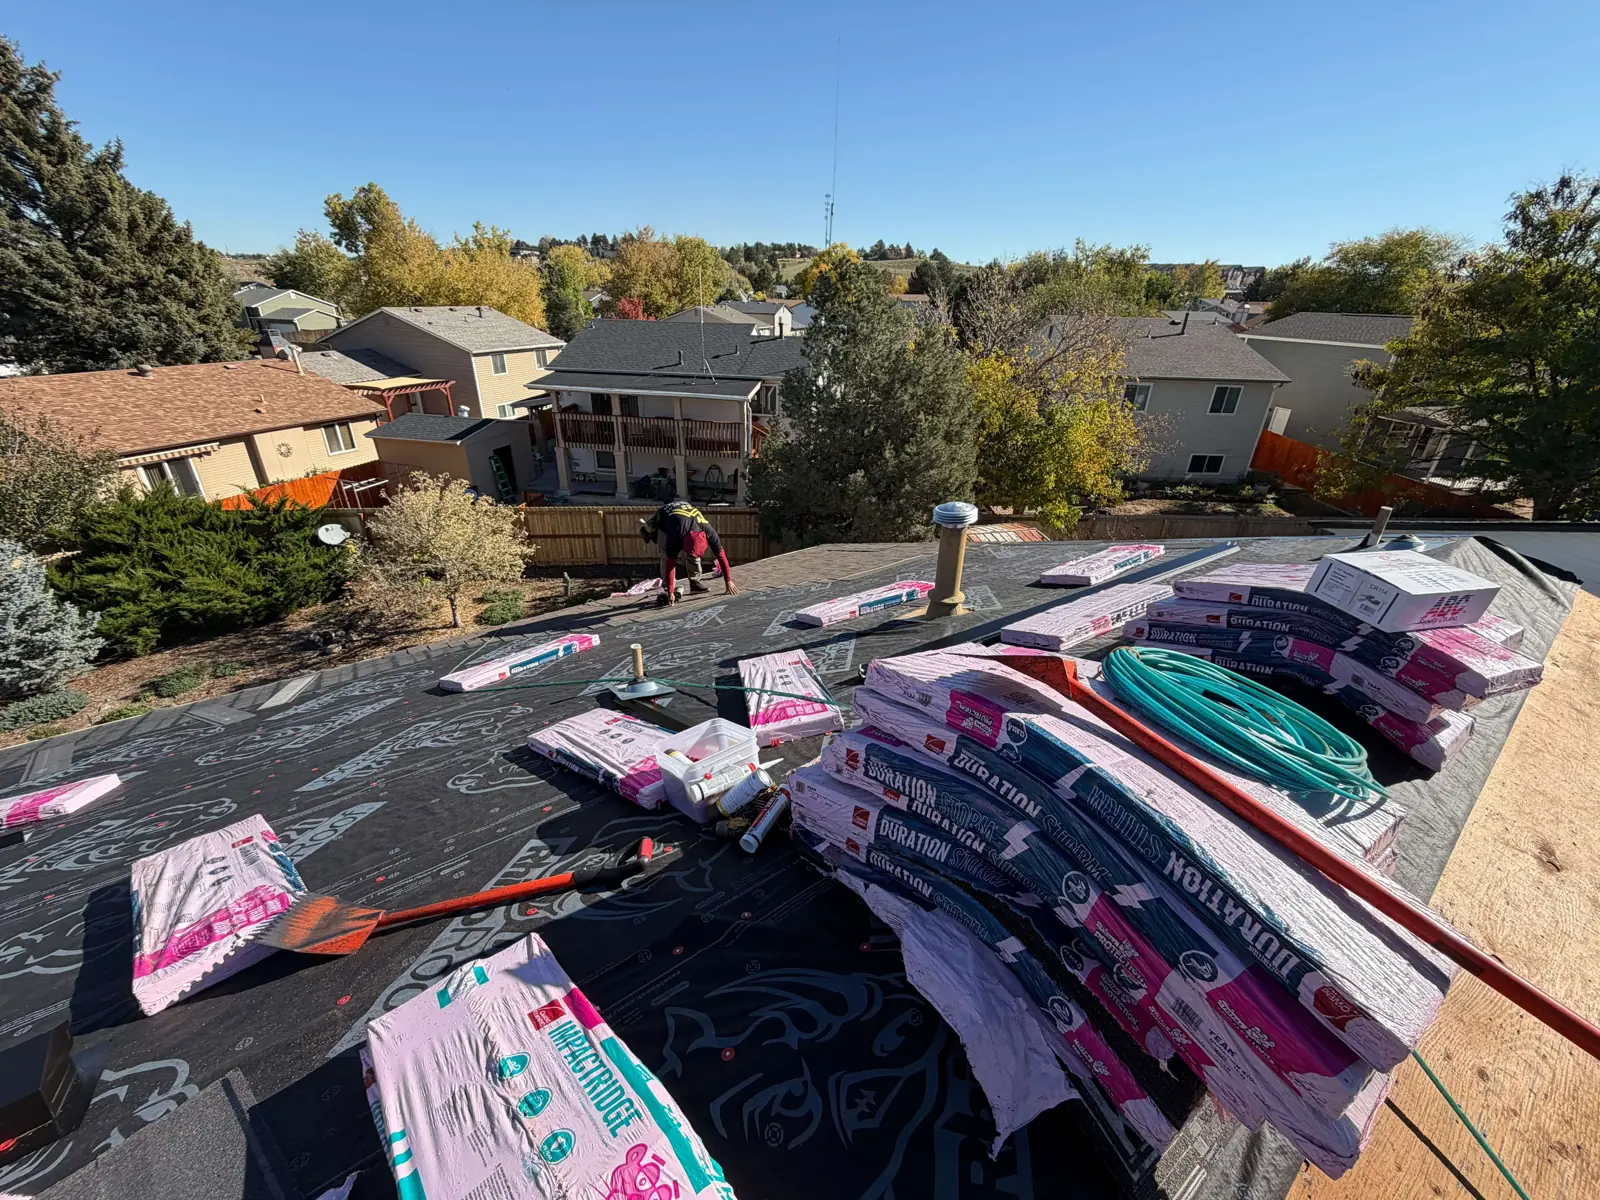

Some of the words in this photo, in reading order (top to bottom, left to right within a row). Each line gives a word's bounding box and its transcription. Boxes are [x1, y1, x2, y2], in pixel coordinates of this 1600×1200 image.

[1369, 583, 1389, 596] CR114
[867, 761, 937, 807] DURATION
[953, 752, 1042, 818] DURATION
[880, 818, 952, 863] DURATION
[1163, 850, 1302, 977] DURATION
[1099, 981, 1140, 1032] PROTECTION
[547, 1019, 643, 1139] IMPACTRIDGE
